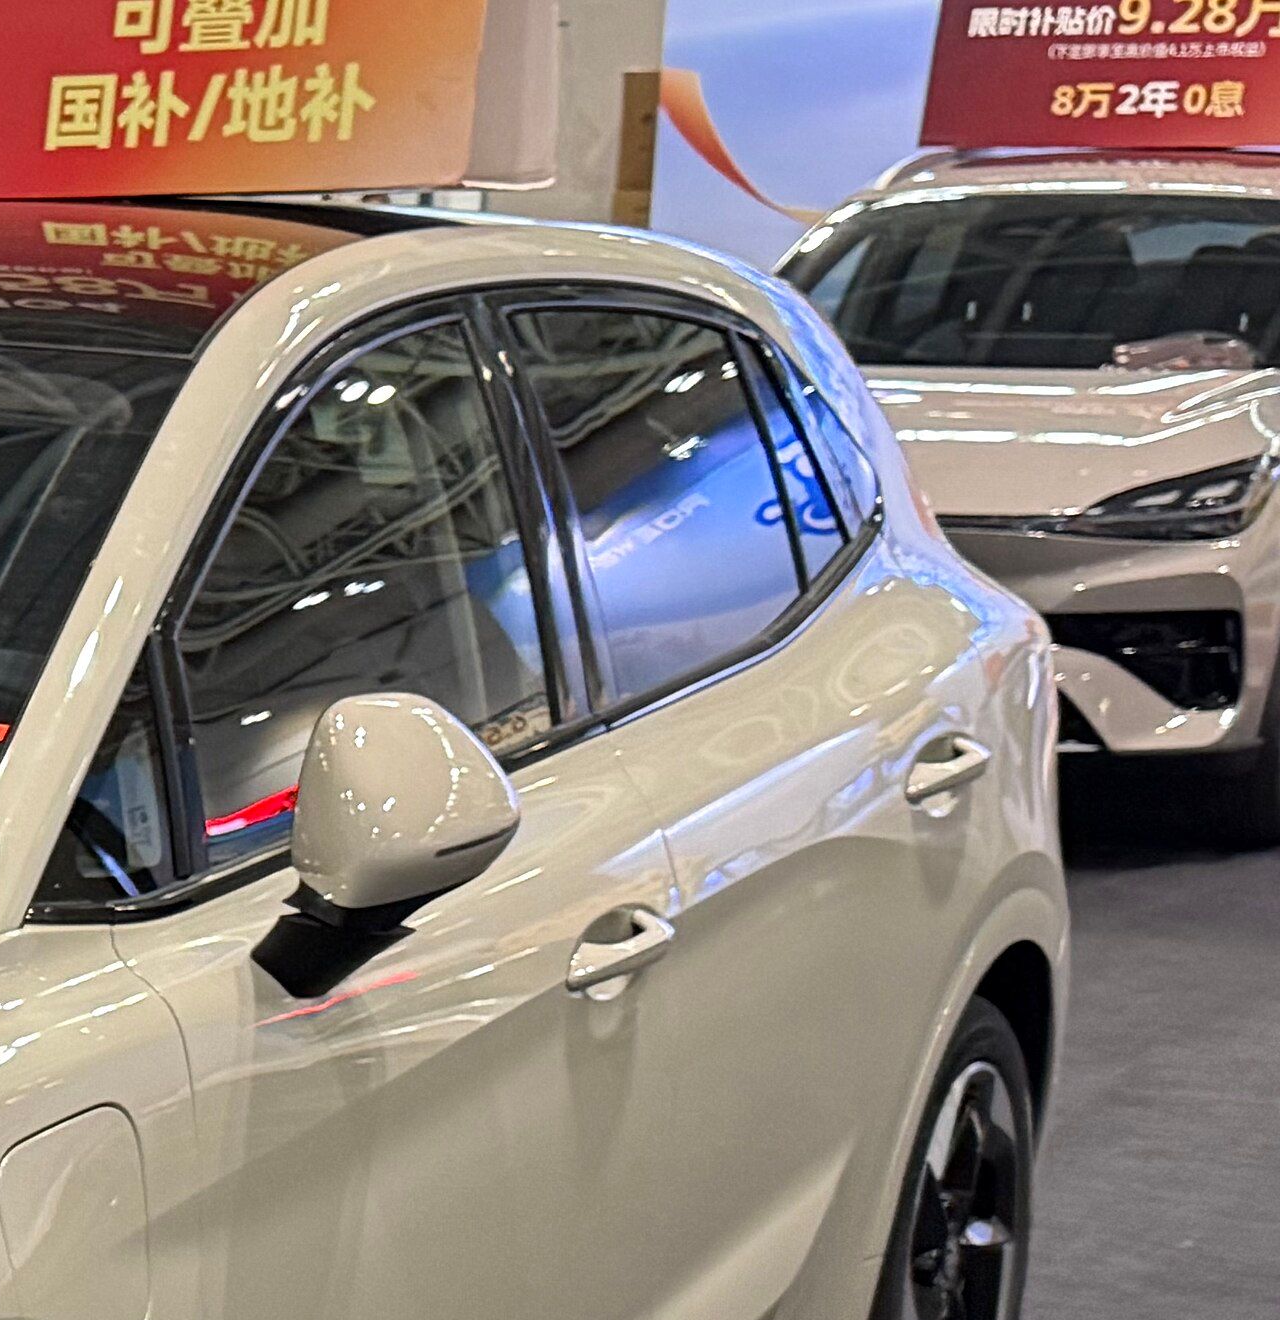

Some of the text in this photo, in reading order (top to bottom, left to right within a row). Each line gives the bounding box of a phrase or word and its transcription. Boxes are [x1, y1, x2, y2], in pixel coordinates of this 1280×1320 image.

[114, 0, 329, 54] 可叠加
[968, 6, 1116, 37] 限时补贴价
[44, 62, 376, 151] 国补/地补
[1050, 80, 1245, 118] 8万 2年 0息
